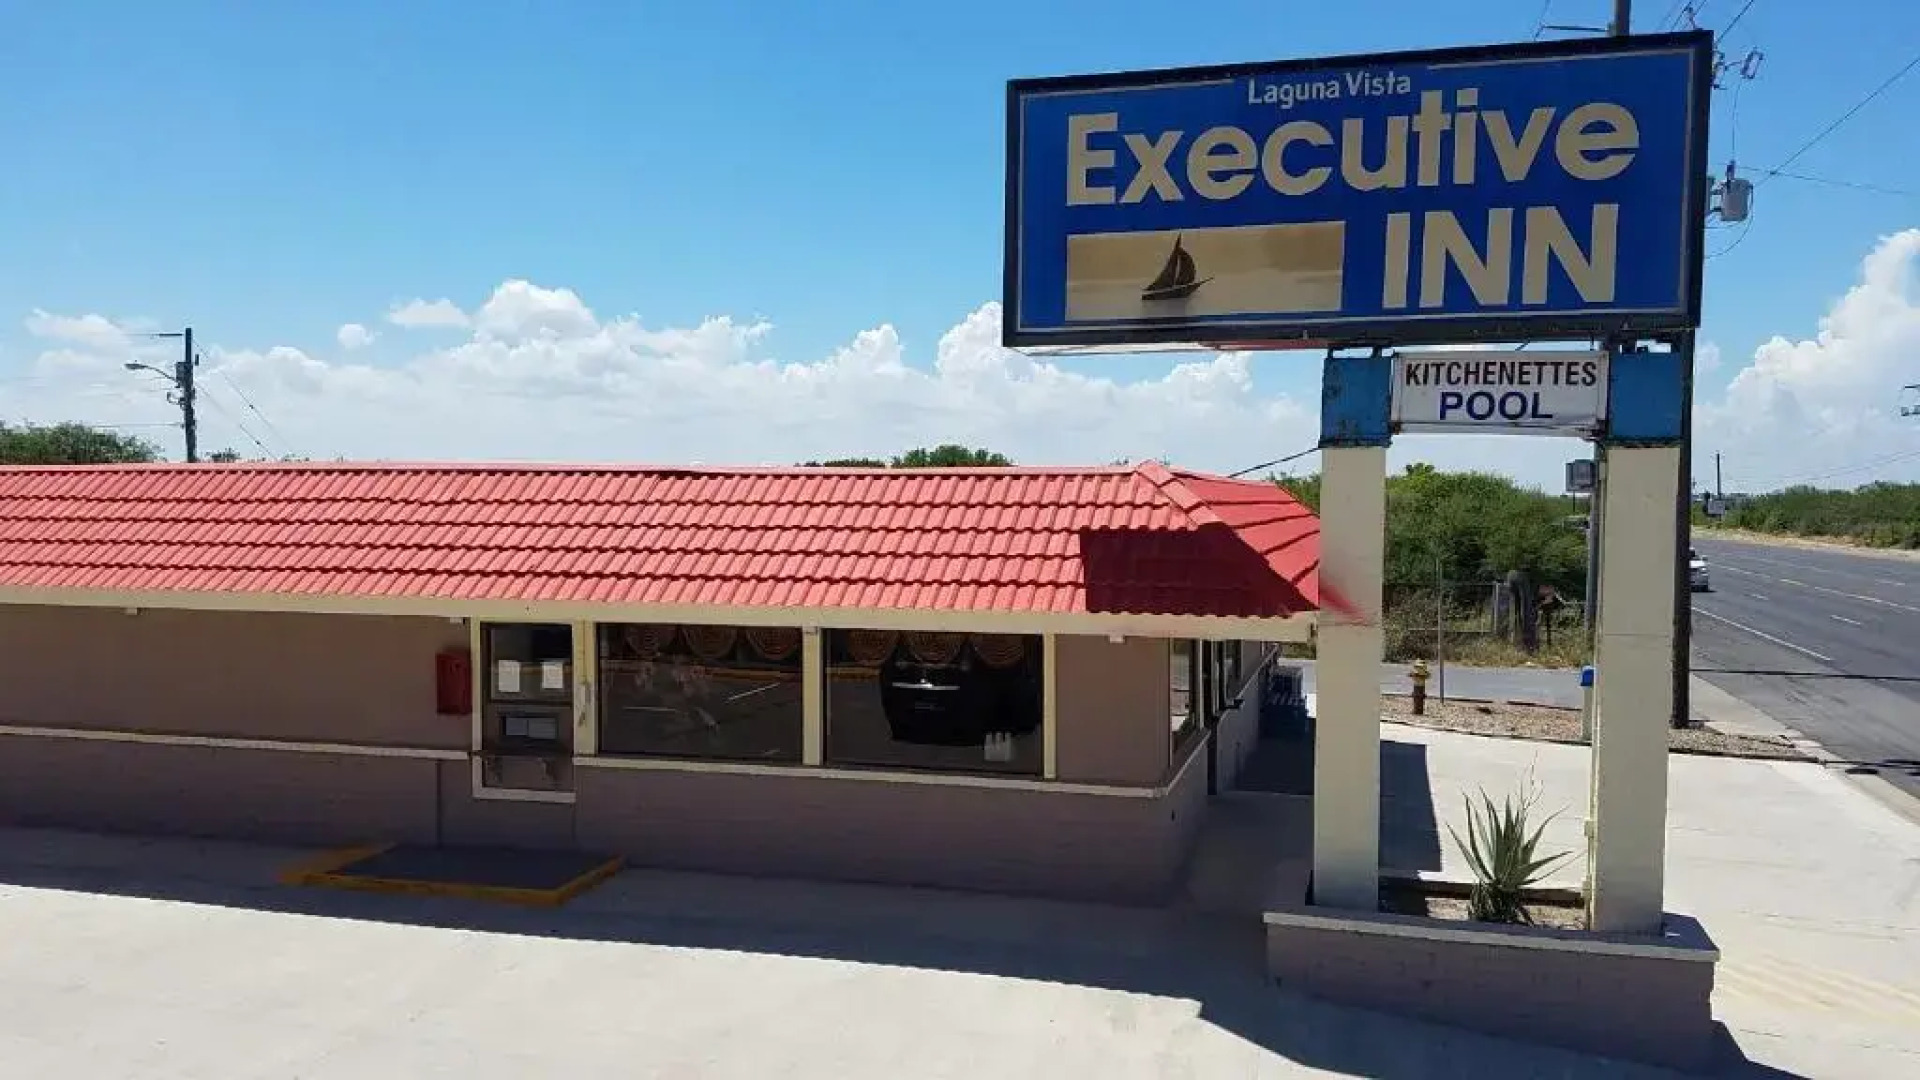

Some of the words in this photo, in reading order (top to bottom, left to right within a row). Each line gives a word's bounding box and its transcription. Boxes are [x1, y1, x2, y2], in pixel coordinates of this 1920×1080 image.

[1248, 79, 1340, 109] Laguna
[1346, 71, 1411, 97] Vista
[1066, 89, 1639, 206] Executive
[1383, 204, 1619, 308] INN
[1405, 361, 1597, 386] KITCHENETTES
[1439, 391, 1553, 421] POOL
